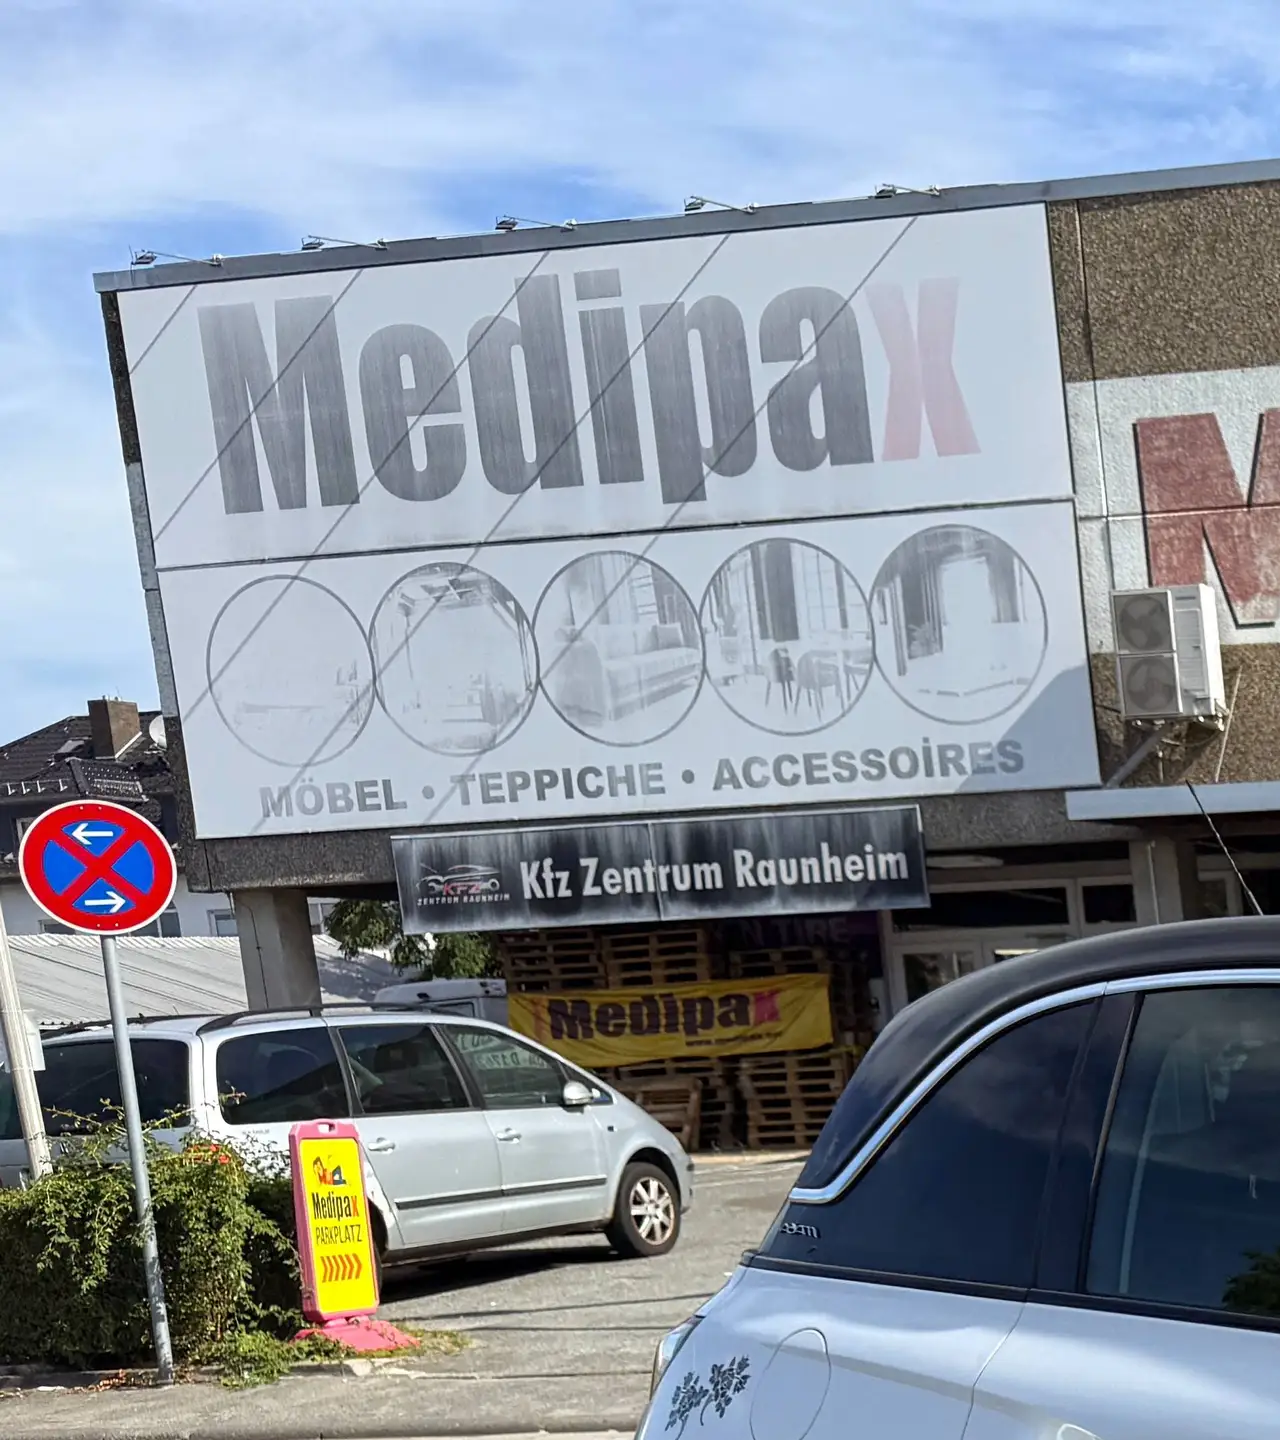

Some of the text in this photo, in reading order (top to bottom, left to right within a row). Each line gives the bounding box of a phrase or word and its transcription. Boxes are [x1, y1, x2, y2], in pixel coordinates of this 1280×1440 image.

[198, 268, 981, 513] Medipax
[260, 773, 408, 819] MÖBEL
[448, 764, 668, 804] TEPPICHE
[442, 881, 482, 895] KFZ
[520, 842, 909, 900] Kfz Zentrum Raunheim
[548, 989, 782, 1040] Medipax
[311, 1191, 360, 1222] Medipax
[315, 1224, 363, 1246] PARKPLATZ
